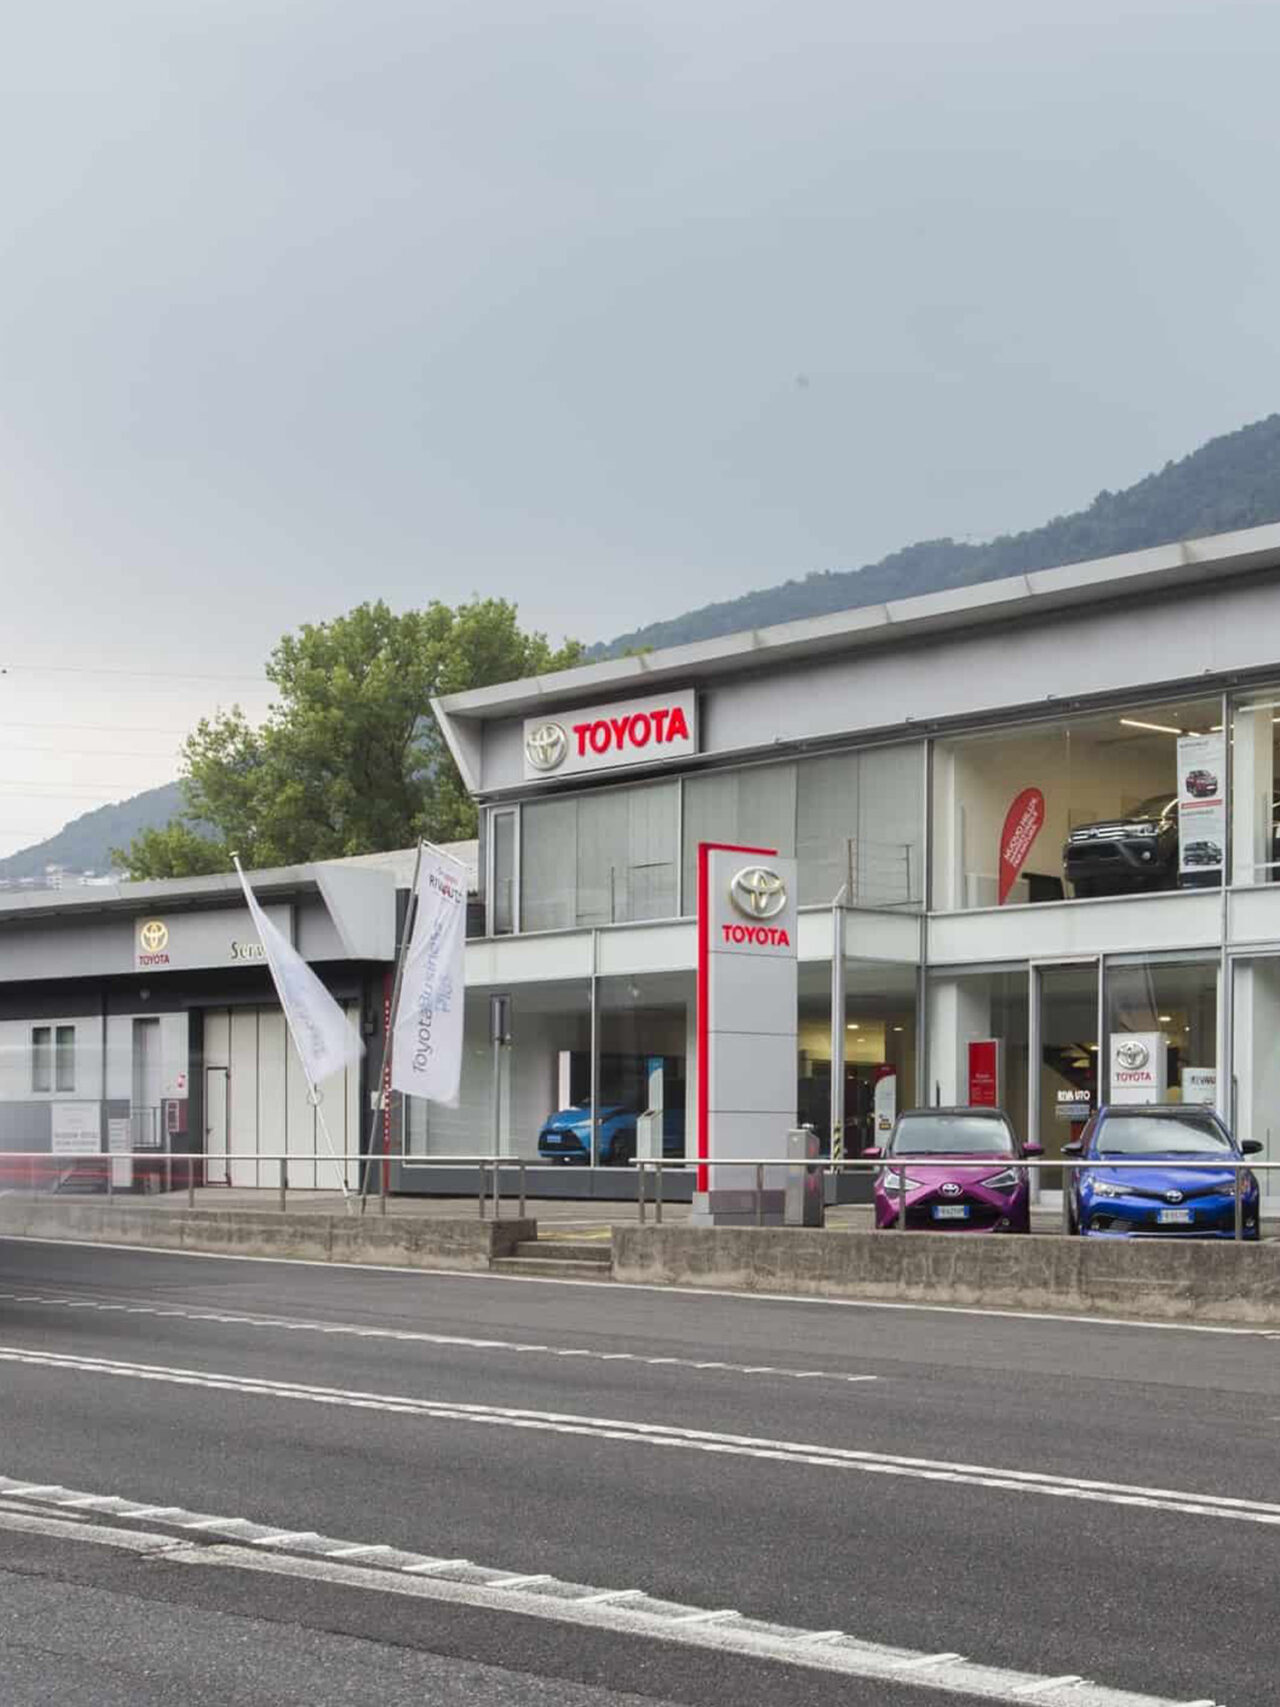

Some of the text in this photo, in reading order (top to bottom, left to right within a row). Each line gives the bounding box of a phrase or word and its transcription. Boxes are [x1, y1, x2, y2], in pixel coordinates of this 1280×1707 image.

[573, 706, 689, 757] TOYOTA
[722, 924, 790, 947] TOYOTA
[139, 954, 170, 965] TOYOTA
[1115, 1072, 1152, 1082] TOYOTA
